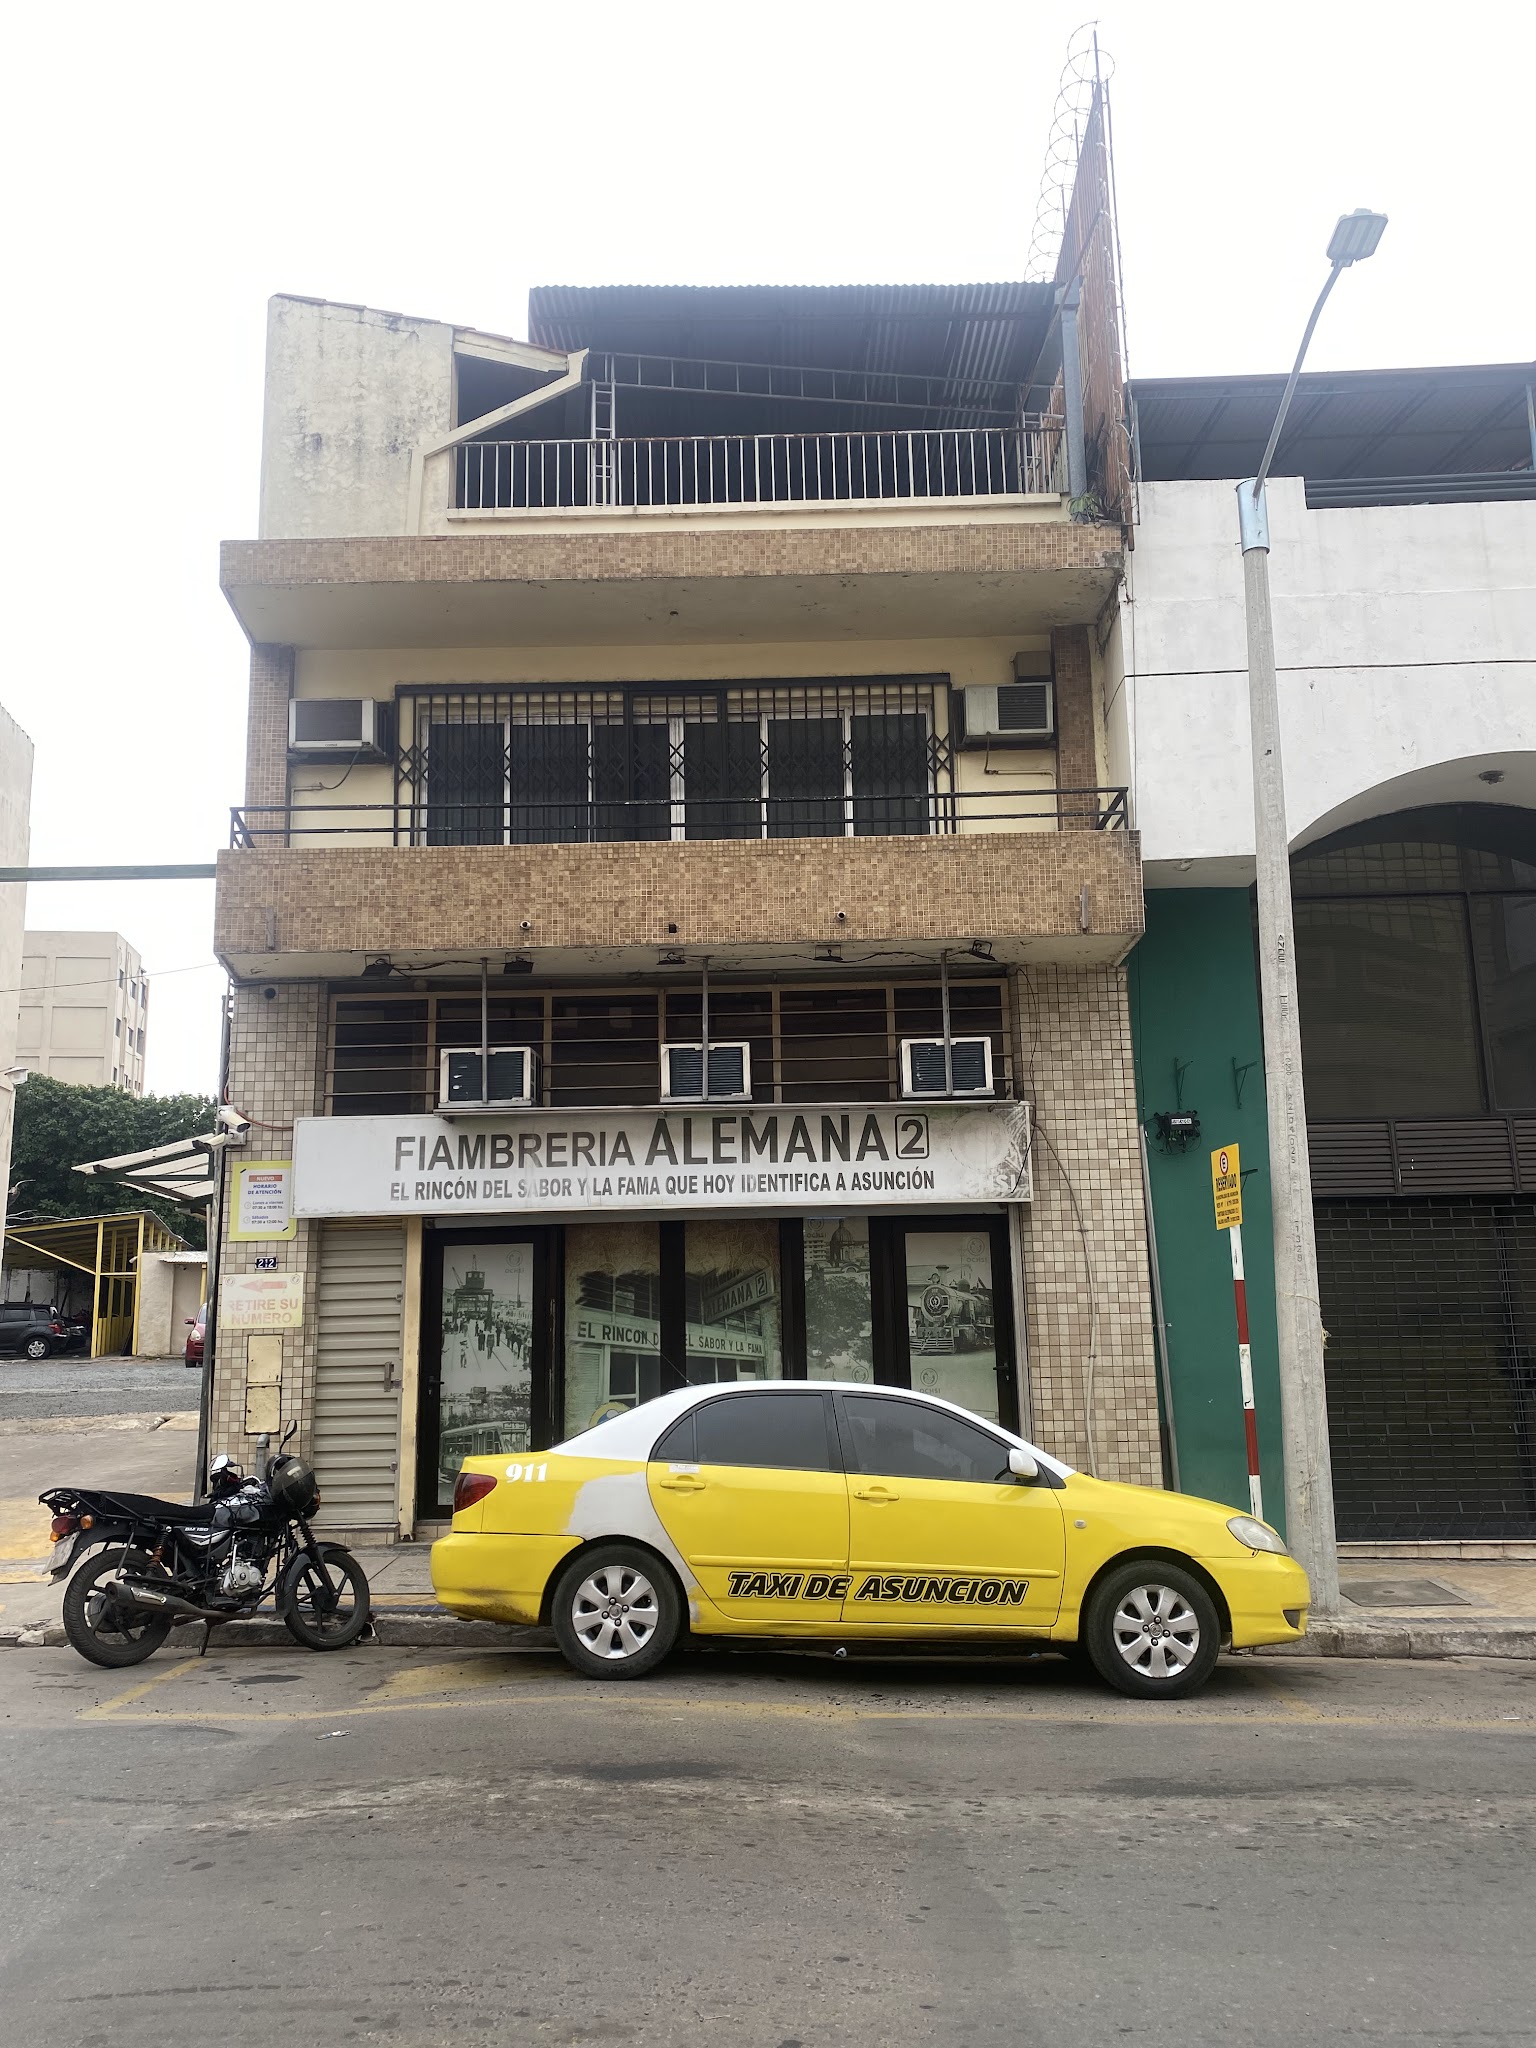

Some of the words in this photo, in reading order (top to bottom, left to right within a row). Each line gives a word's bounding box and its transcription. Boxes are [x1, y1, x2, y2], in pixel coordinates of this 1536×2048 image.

[395, 1131, 635, 1171] FIAMBRERIA
[645, 1114, 889, 1165] ALEMANA
[900, 1119, 925, 1155] 2
[390, 1182, 409, 1201] EL
[415, 1176, 477, 1200] RINCÓN
[482, 1179, 512, 1199] DEL
[518, 1177, 572, 1198] SABOR
[577, 1178, 588, 1196] Y
[593, 1177, 613, 1196] LA
[618, 1176, 660, 1196] FAMA
[666, 1174, 698, 1196] QUE
[703, 1174, 735, 1194] HOY
[741, 1172, 831, 1193] IDENTIFICA
[835, 1172, 847, 1192] A
[851, 1166, 935, 1190] ASUNCIÓN
[258, 1258, 275, 1268] 212
[280, 1298, 299, 1310] SU
[578, 1321, 596, 1339] EL
[698, 1336, 727, 1351] SABOR
[735, 1340, 745, 1353] LA
[747, 1342, 763, 1354] FAMA
[505, 1463, 547, 1484] 911
[728, 1571, 803, 1599] TAXI
[802, 1574, 852, 1600] DE
[855, 1576, 1029, 1606] ASUNCION
